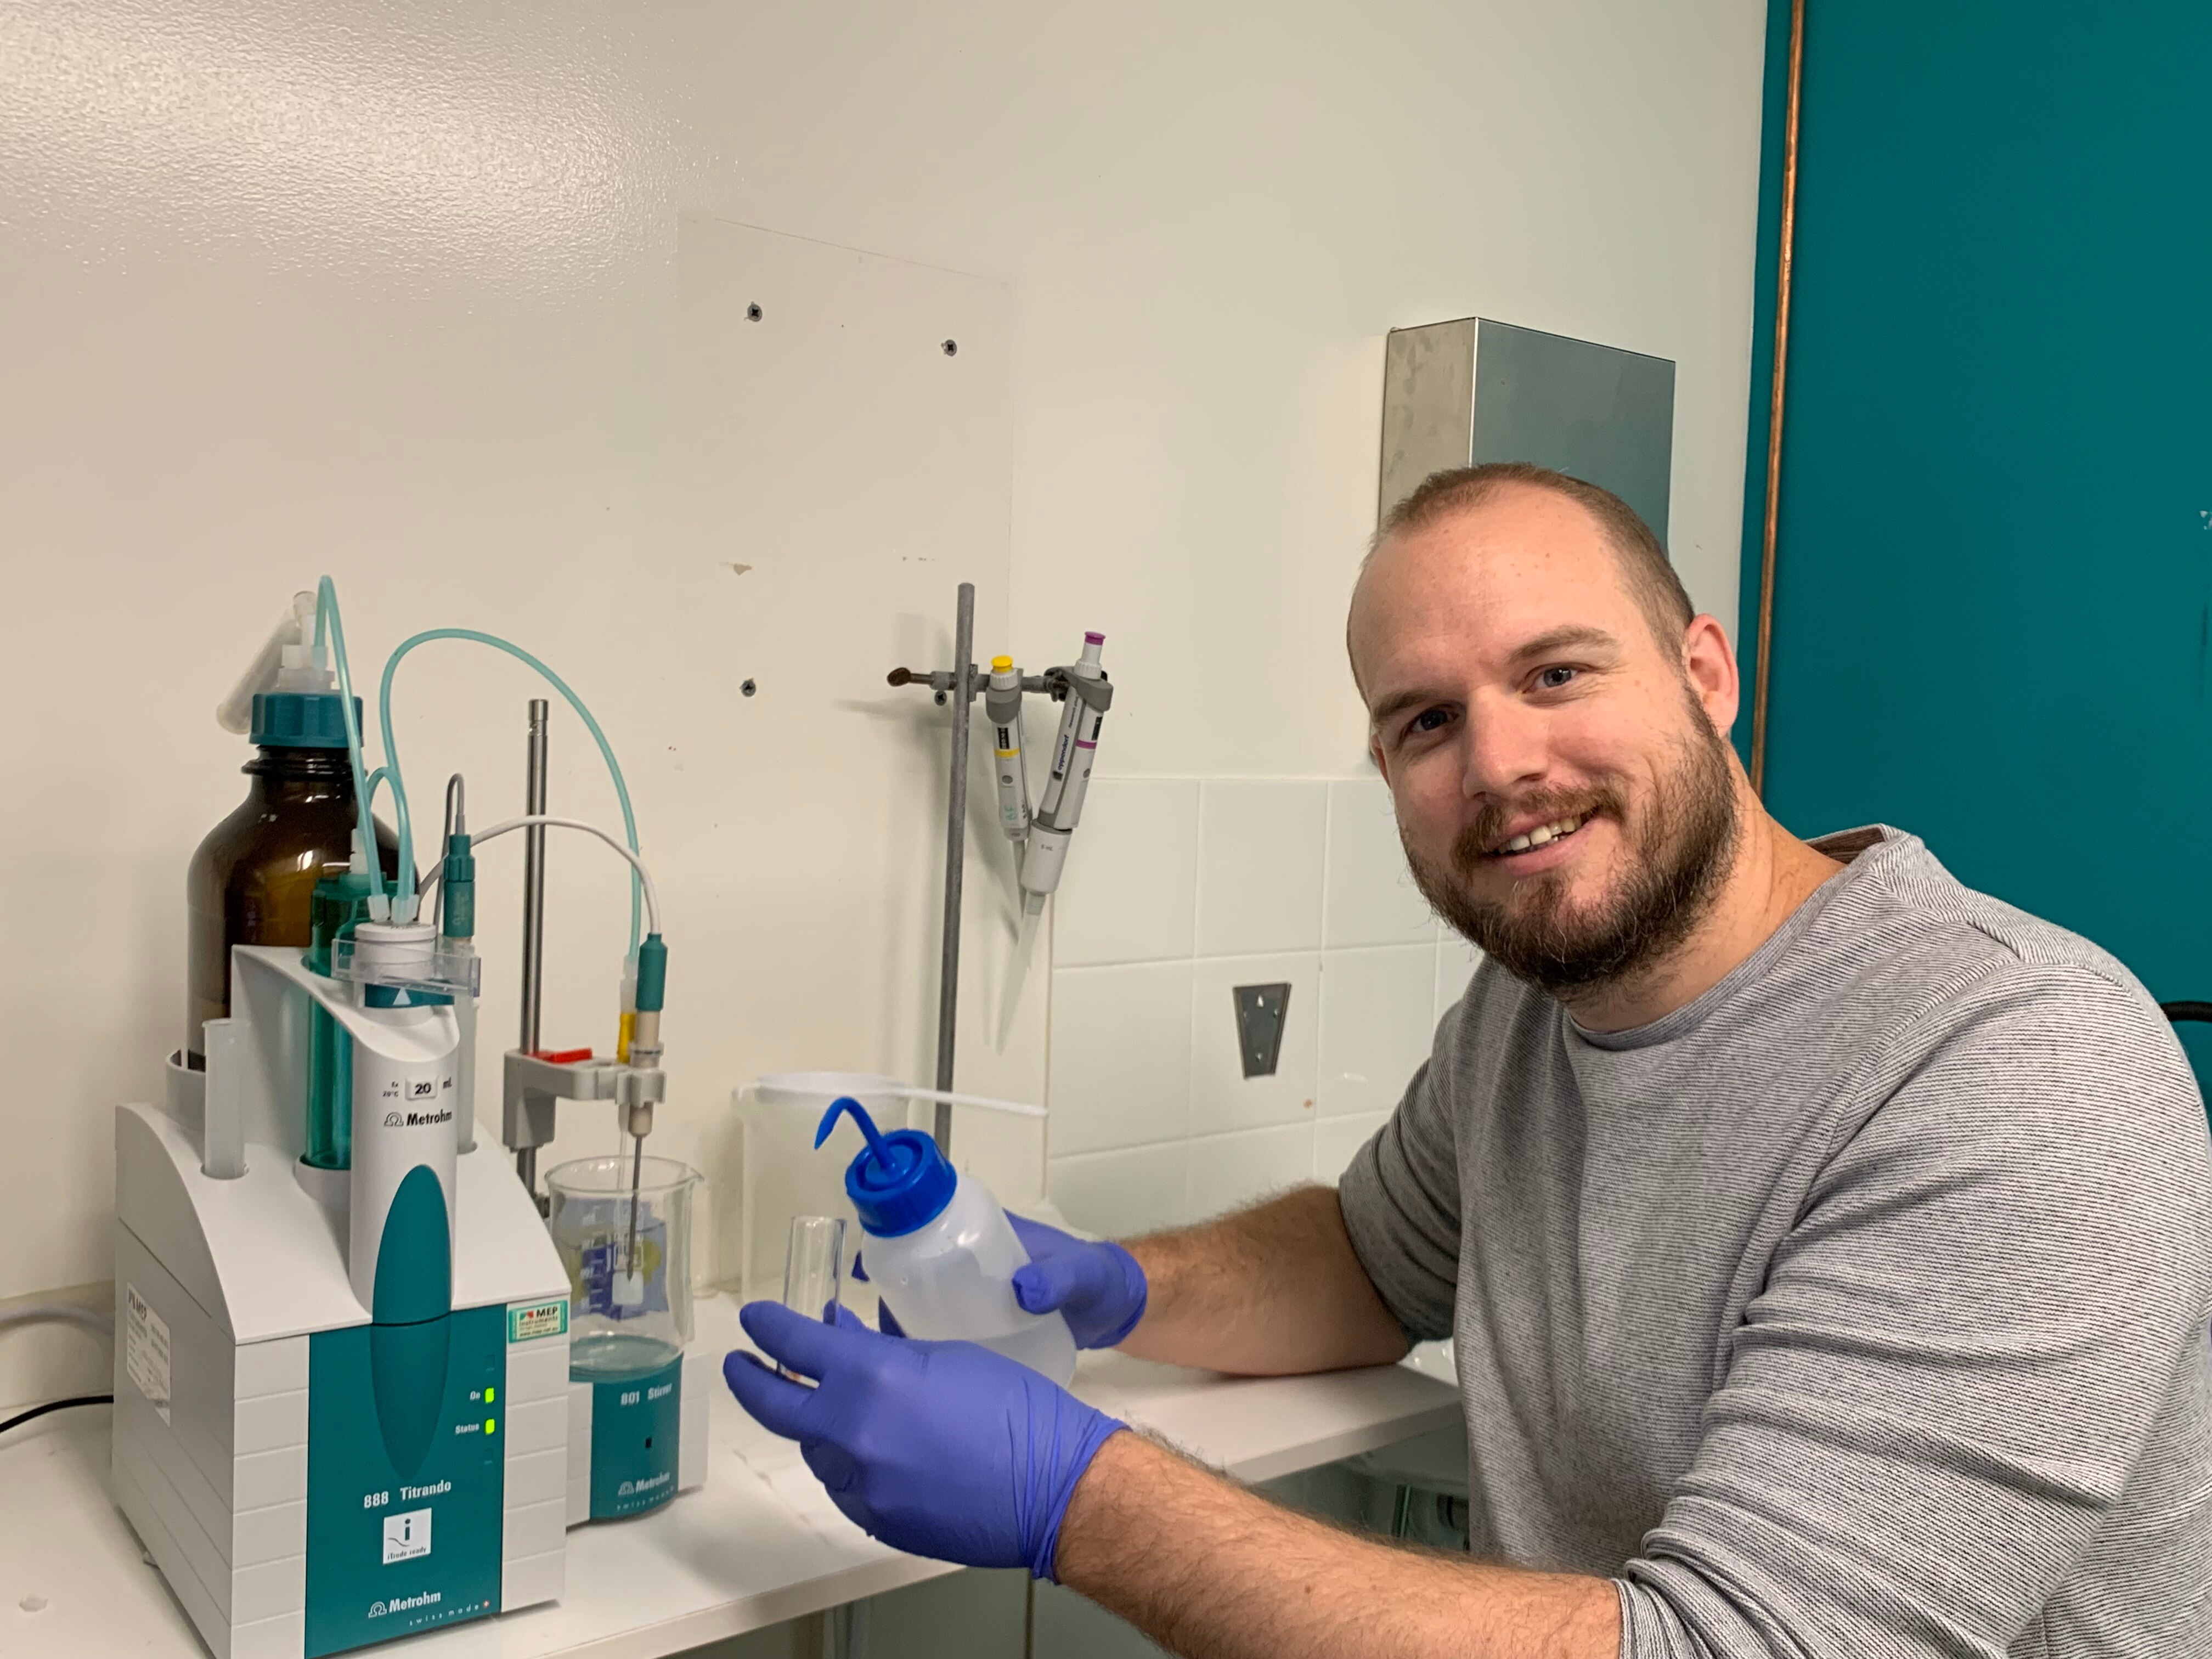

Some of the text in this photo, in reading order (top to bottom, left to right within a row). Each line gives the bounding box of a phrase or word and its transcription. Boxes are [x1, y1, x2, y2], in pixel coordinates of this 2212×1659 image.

[1058, 734, 1070, 771] eppendorf
[414, 1082, 432, 1095] 20
[407, 1108, 452, 1127] Metrohm
[536, 1306, 558, 1318] MEP
[470, 1391, 481, 1401] On
[455, 1423, 479, 1435] Status
[364, 1479, 452, 1508] 888 Titrando
[409, 1546, 427, 1555] ready
[389, 1591, 441, 1613] Metrohm
[409, 1604, 479, 1626] swiss made
